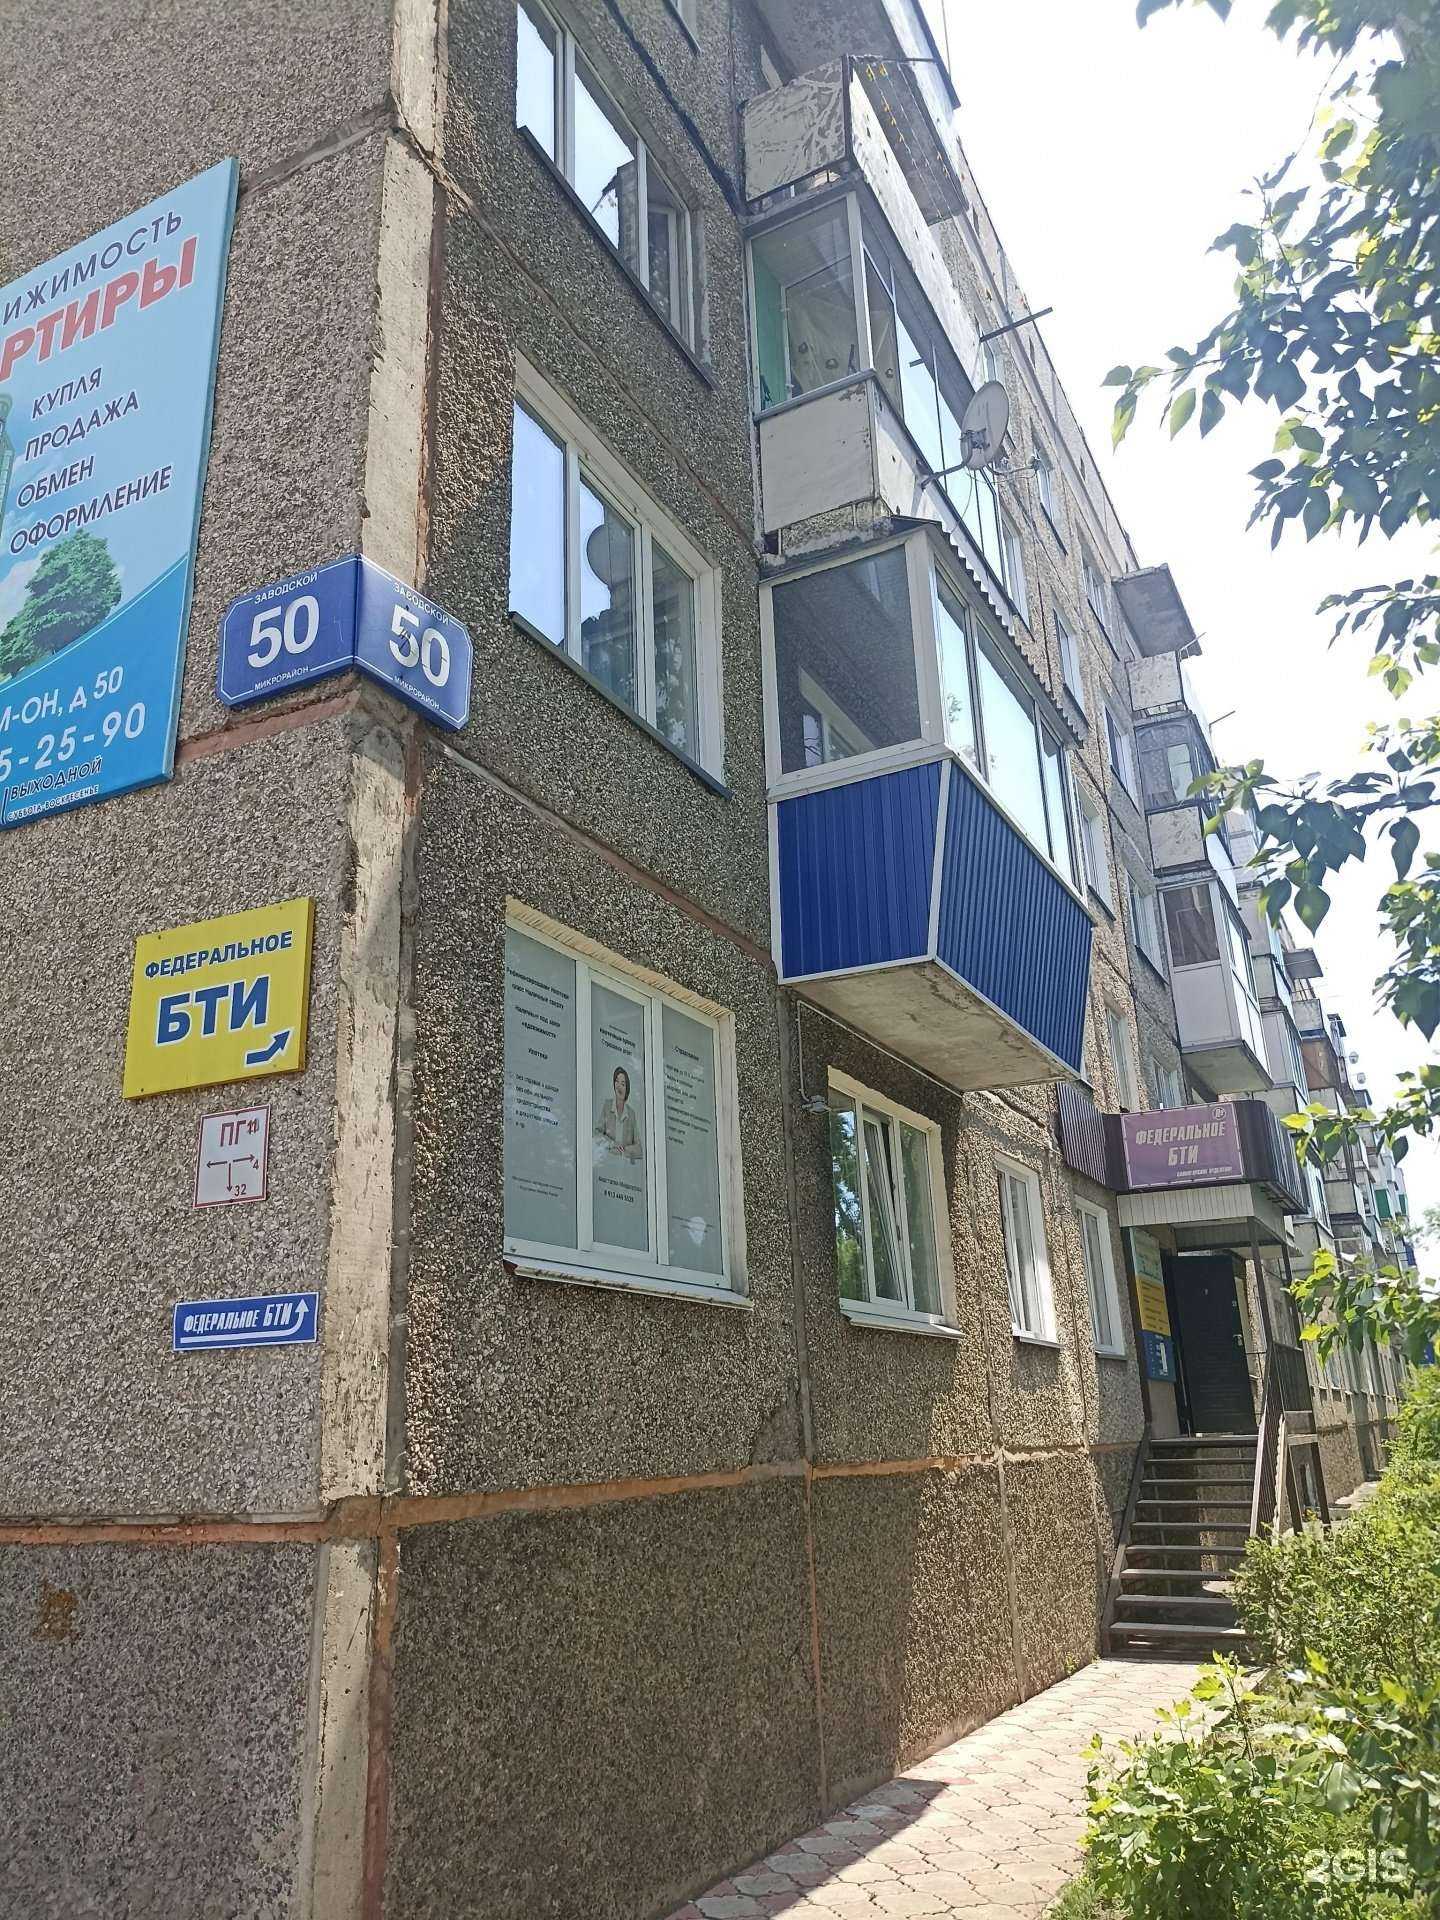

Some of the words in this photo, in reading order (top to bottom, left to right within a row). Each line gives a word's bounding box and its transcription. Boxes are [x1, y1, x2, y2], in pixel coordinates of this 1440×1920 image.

[2, 211, 182, 325] ИЖИМОСТЬ
[0, 237, 197, 382] РТИРЫ
[32, 368, 101, 419] КУПЛЯ
[25, 391, 139, 462] ПРОДАЖА
[17, 456, 95, 508] ОБМЕН
[10, 465, 172, 555] ОФОРМЛЕНИЕ
[253, 571, 318, 605] ЗАВОДСКОЙ
[393, 582, 450, 625] ЗАВОДСКОЙ
[247, 595, 320, 668] 50
[389, 604, 451, 687] 50
[93, 665, 124, 700] 50
[254, 665, 309, 691] МИКРОРАЙОН
[394, 675, 440, 710] МИКРОРАЙОН
[10, 754, 103, 801] ВЫХОДНОЙ
[144, 930, 293, 979] ФЕДЕРАЛЬНОЕ
[156, 976, 270, 1045] БТИ
[220, 1120, 246, 1148] ПГ
[1135, 1121, 1225, 1146] ФЕДЕРАЛЬНОЕ
[1168, 1145, 1199, 1166] БТИ
[253, 1160, 259, 1170] 4
[234, 1184, 247, 1197] 32
[183, 1309, 260, 1334] ФЕДЕРАЛЬНОЕ
[263, 1302, 293, 1327] БТИ
